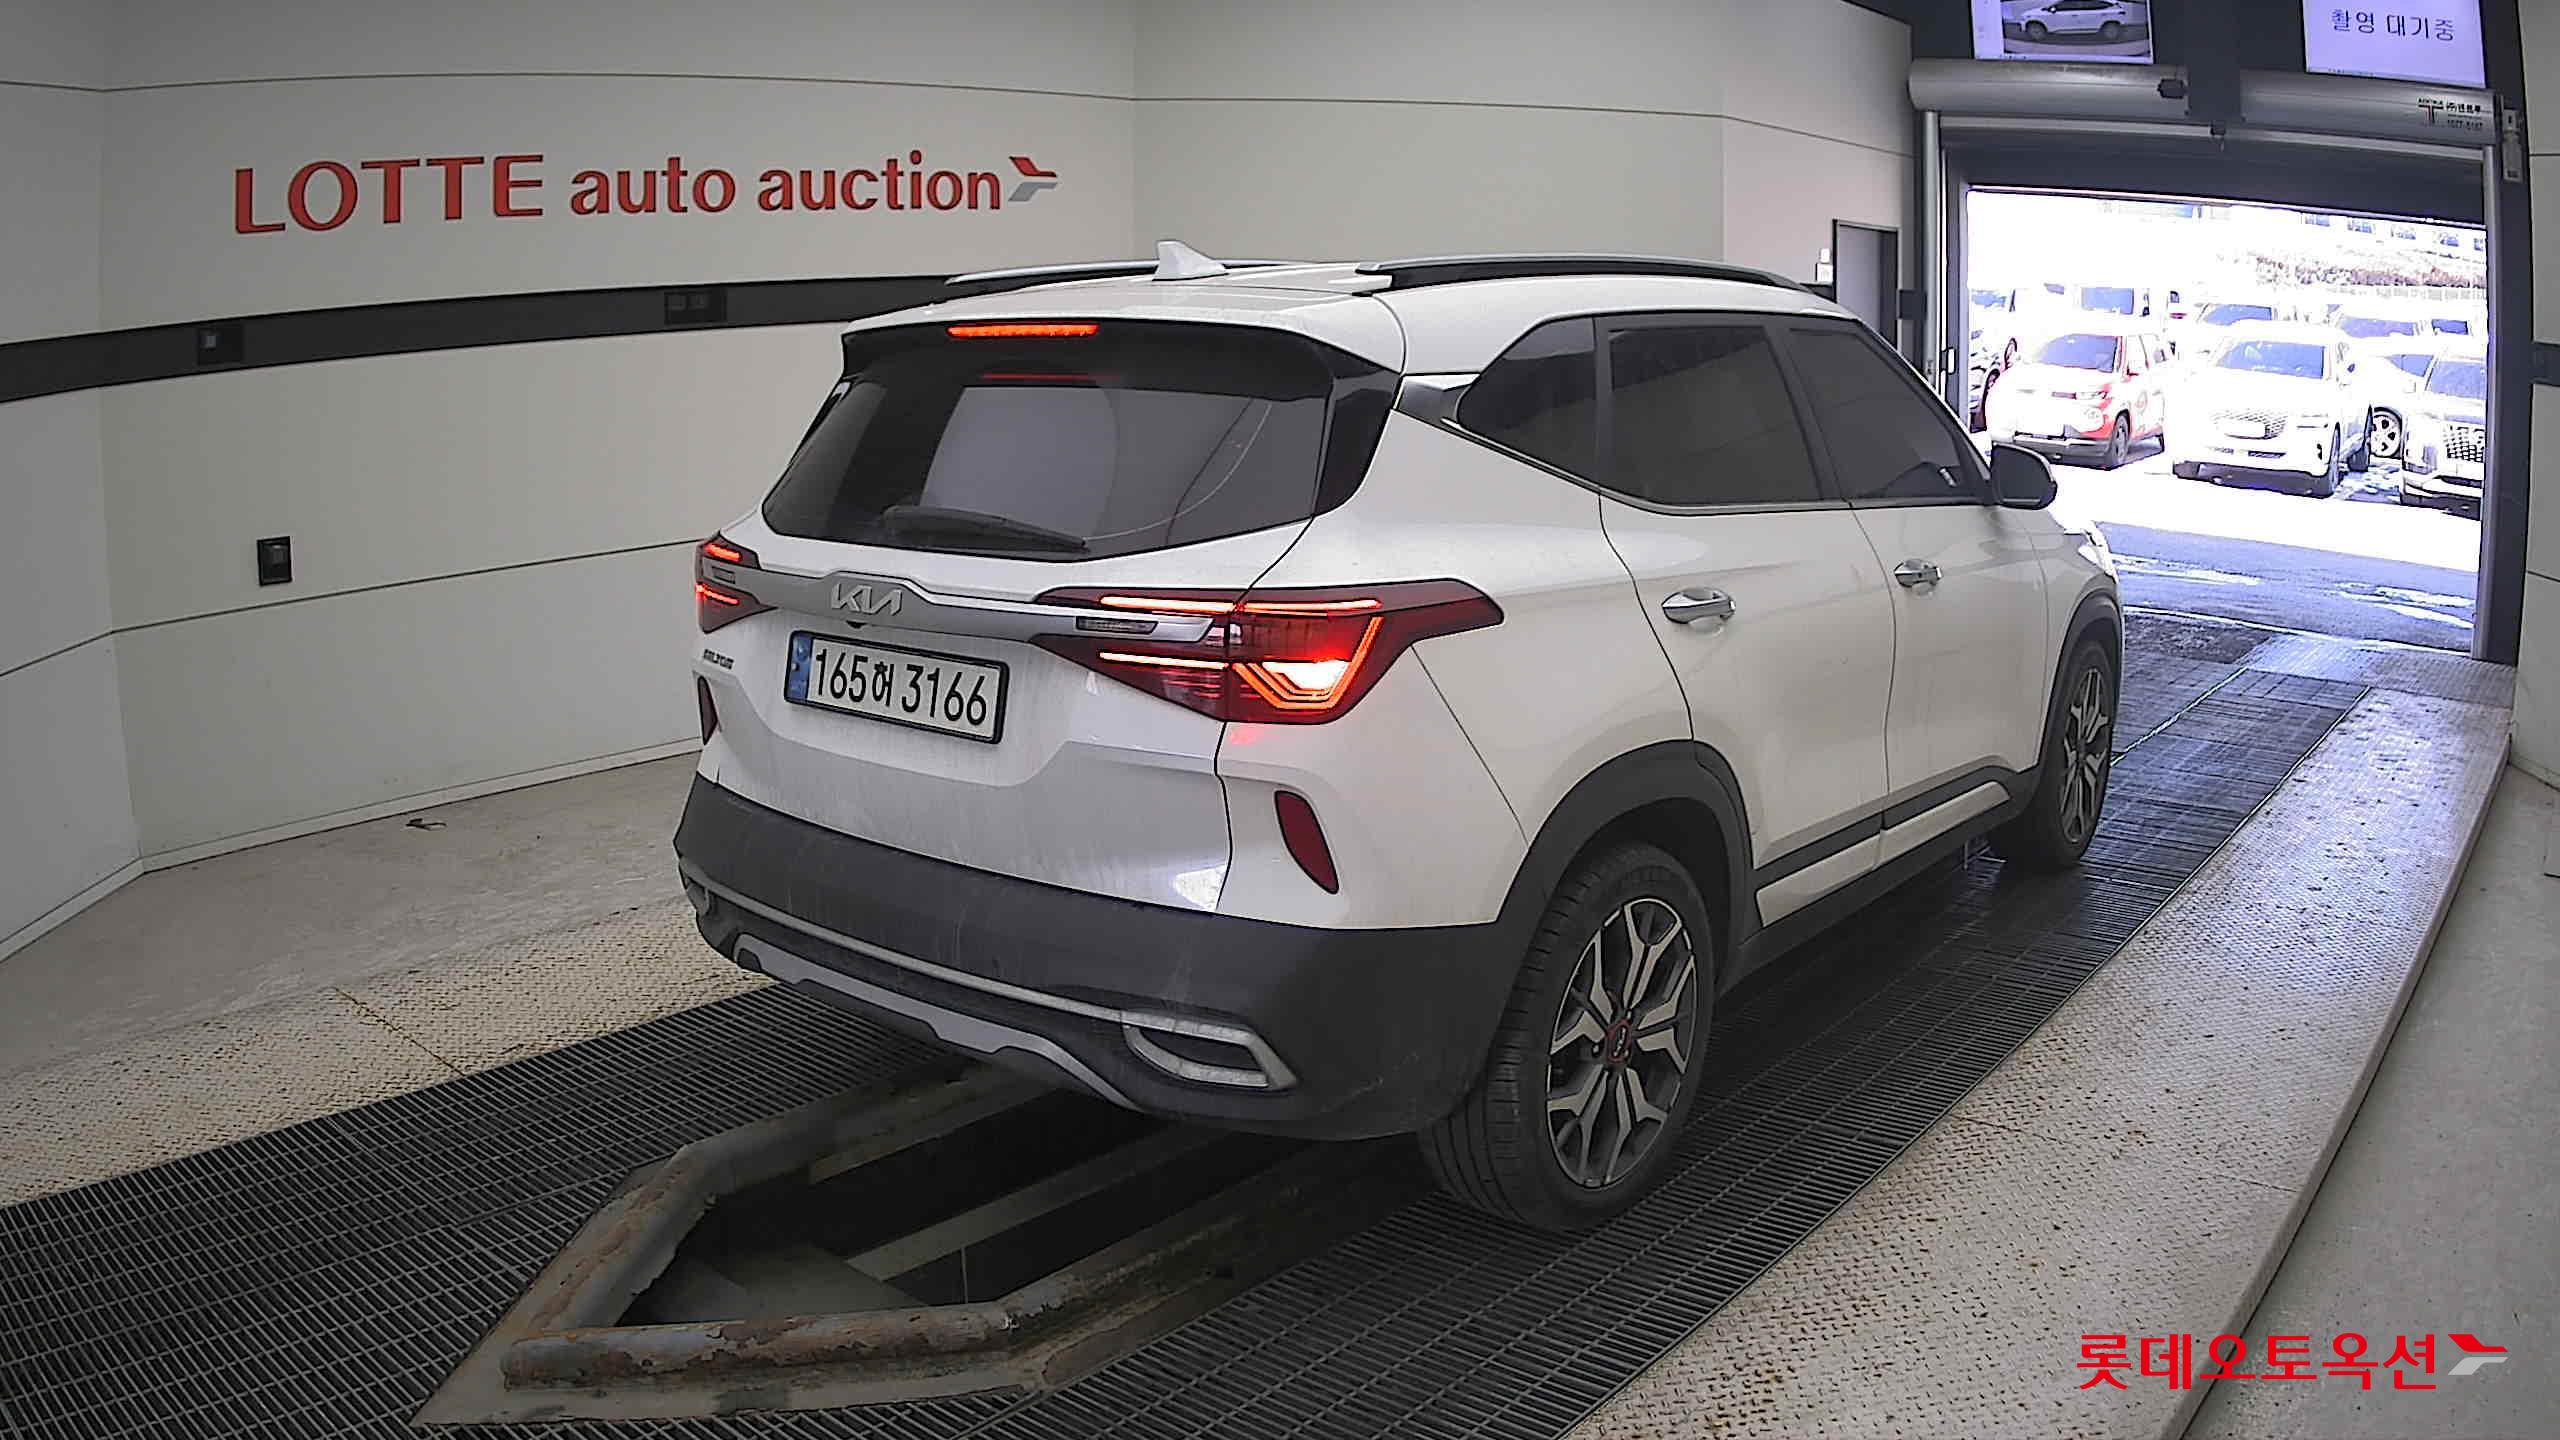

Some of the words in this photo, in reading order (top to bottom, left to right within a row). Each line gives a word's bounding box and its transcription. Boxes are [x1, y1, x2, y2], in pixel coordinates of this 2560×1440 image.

[2330, 9, 2375, 34] 촬영
[2386, 15, 2455, 41] 대기중
[235, 154, 544, 234] LOTTE
[570, 156, 736, 215] auto
[758, 149, 1001, 211] auction
[831, 583, 902, 616] KIA
